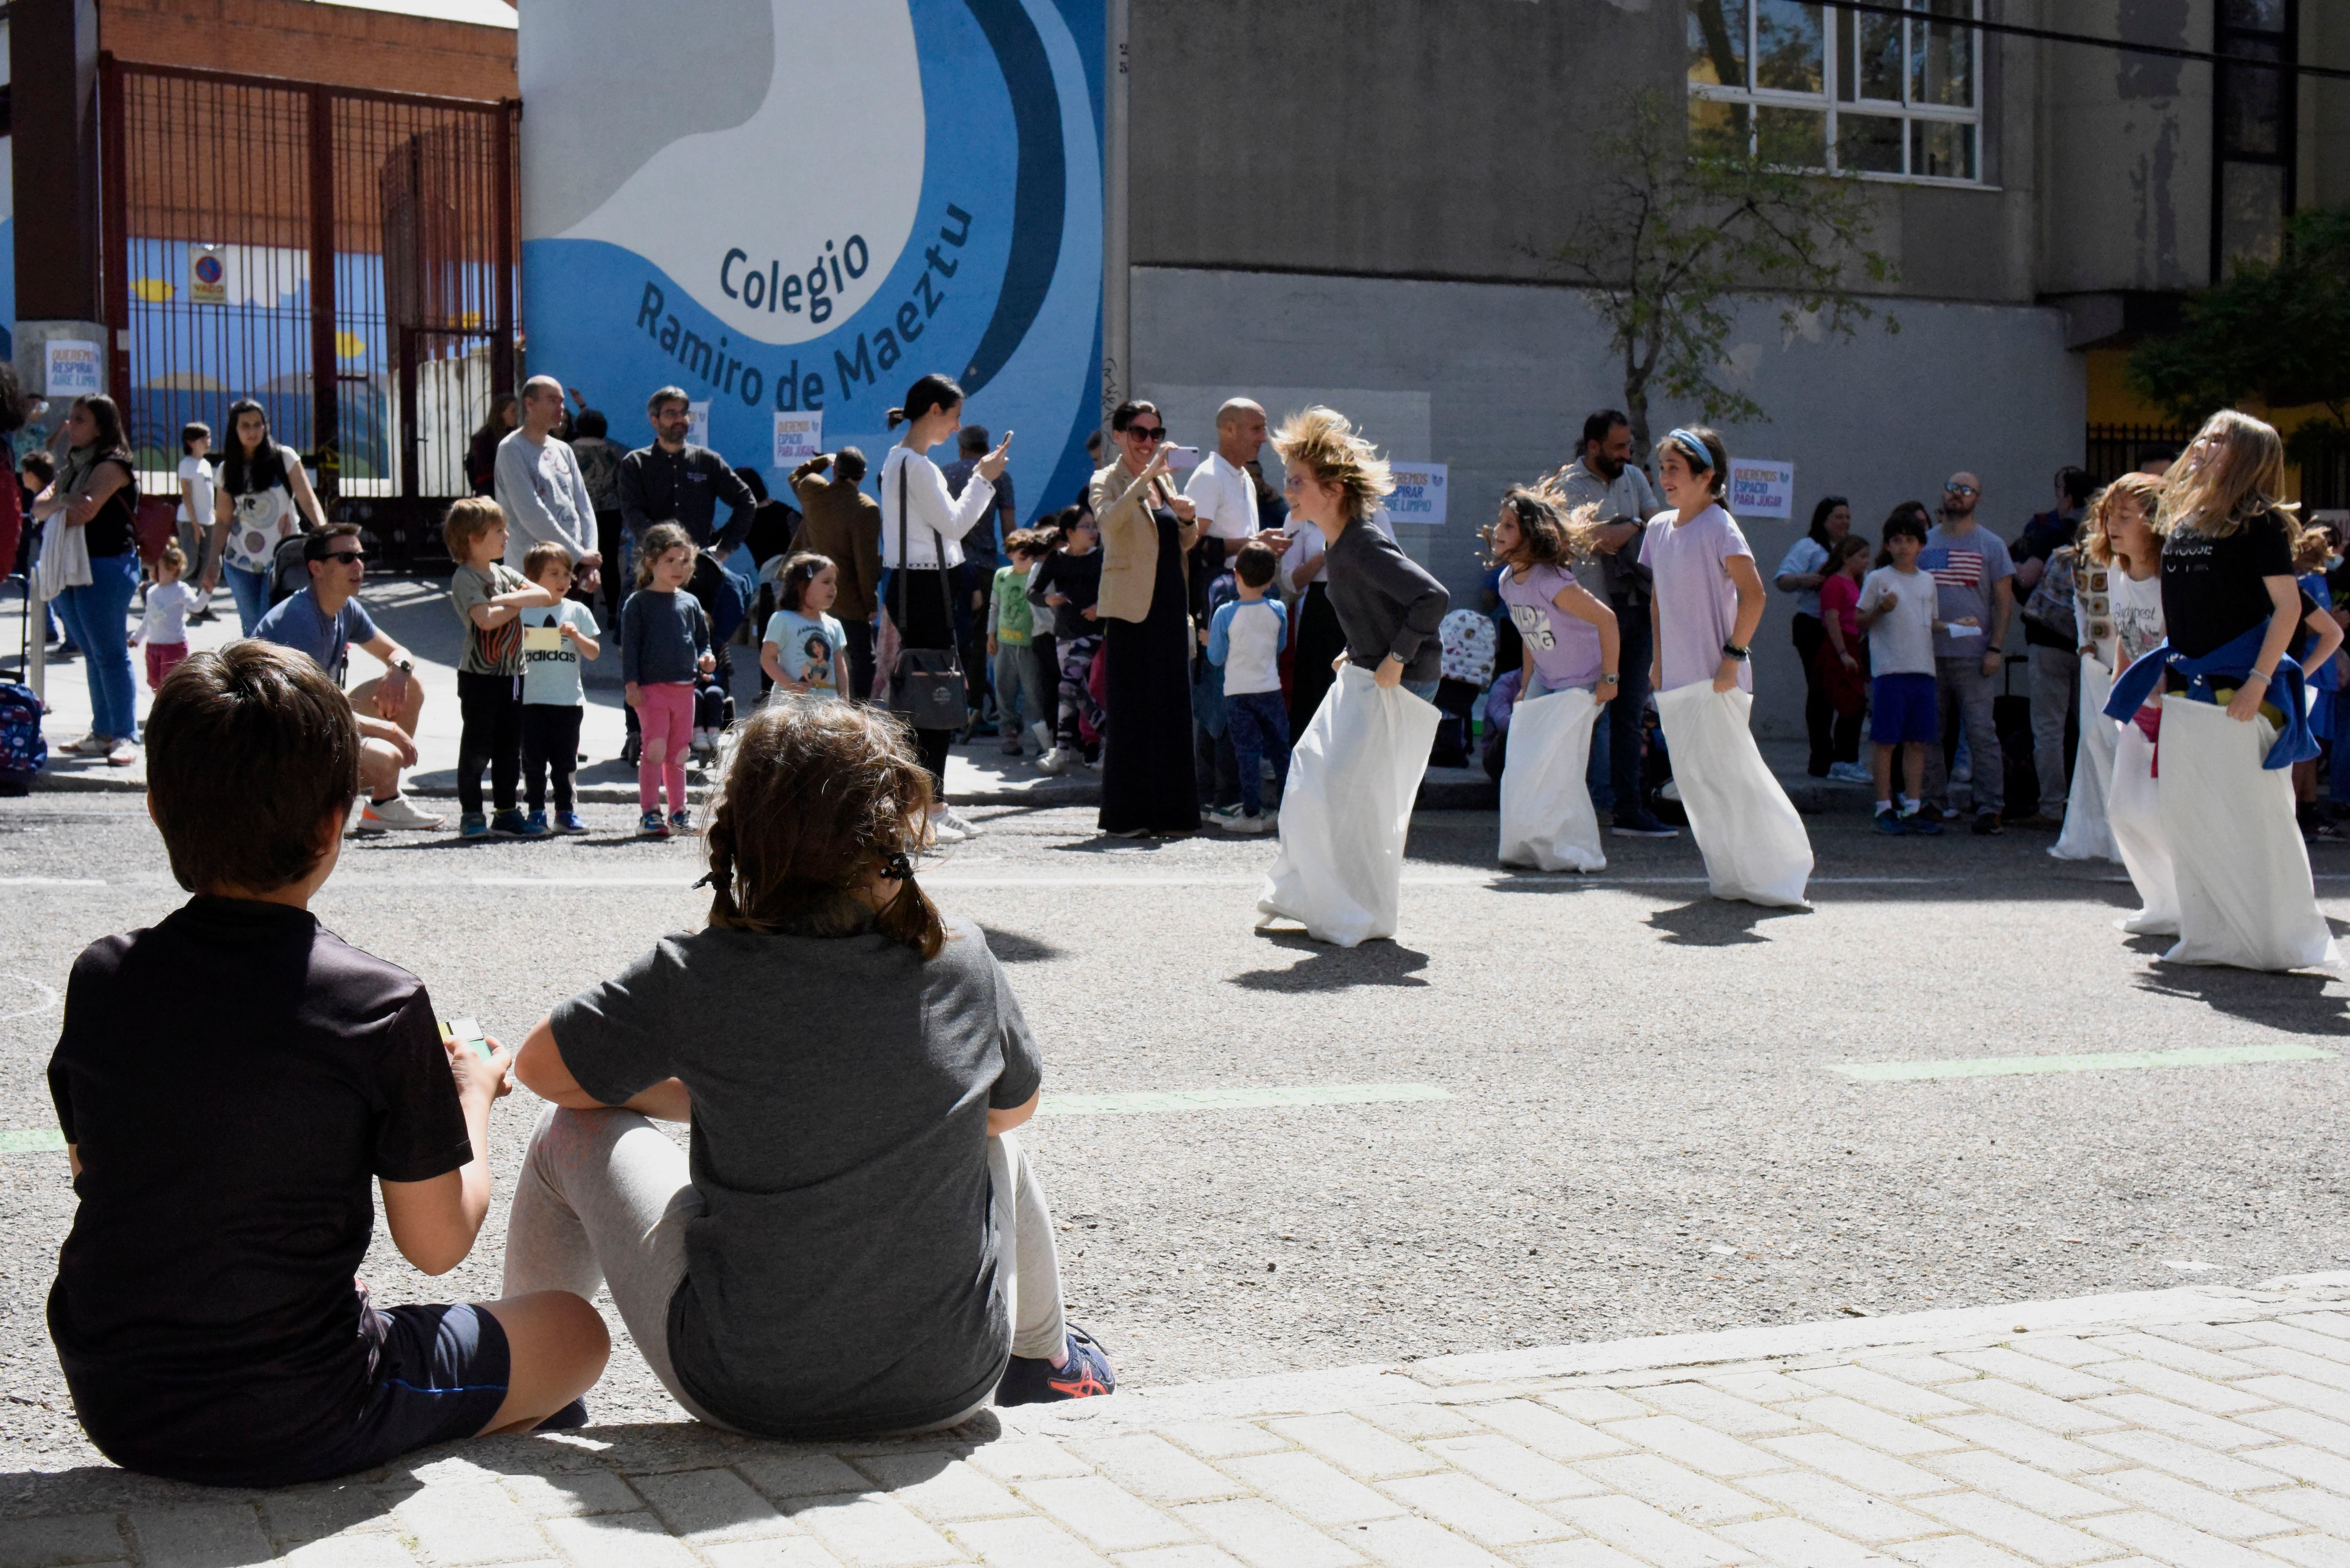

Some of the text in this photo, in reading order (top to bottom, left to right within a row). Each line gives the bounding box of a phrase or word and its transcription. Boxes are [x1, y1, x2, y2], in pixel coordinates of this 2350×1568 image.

[721, 234, 868, 324] Colegio
[637, 281, 763, 406] Ramiro
[776, 360, 824, 412] de
[834, 203, 972, 401] Maeztu
[778, 421, 809, 432] QUEREMOS
[778, 433, 803, 445] ESPACIO
[778, 446, 793, 457] PARA
[1735, 468, 1777, 482] QUEREMOS
[1734, 480, 1768, 493] ESPACIO
[1401, 499, 1431, 512] LIMPIO
[1734, 493, 1782, 507] PARA JUGAR
[1522, 631, 1556, 650] ING
